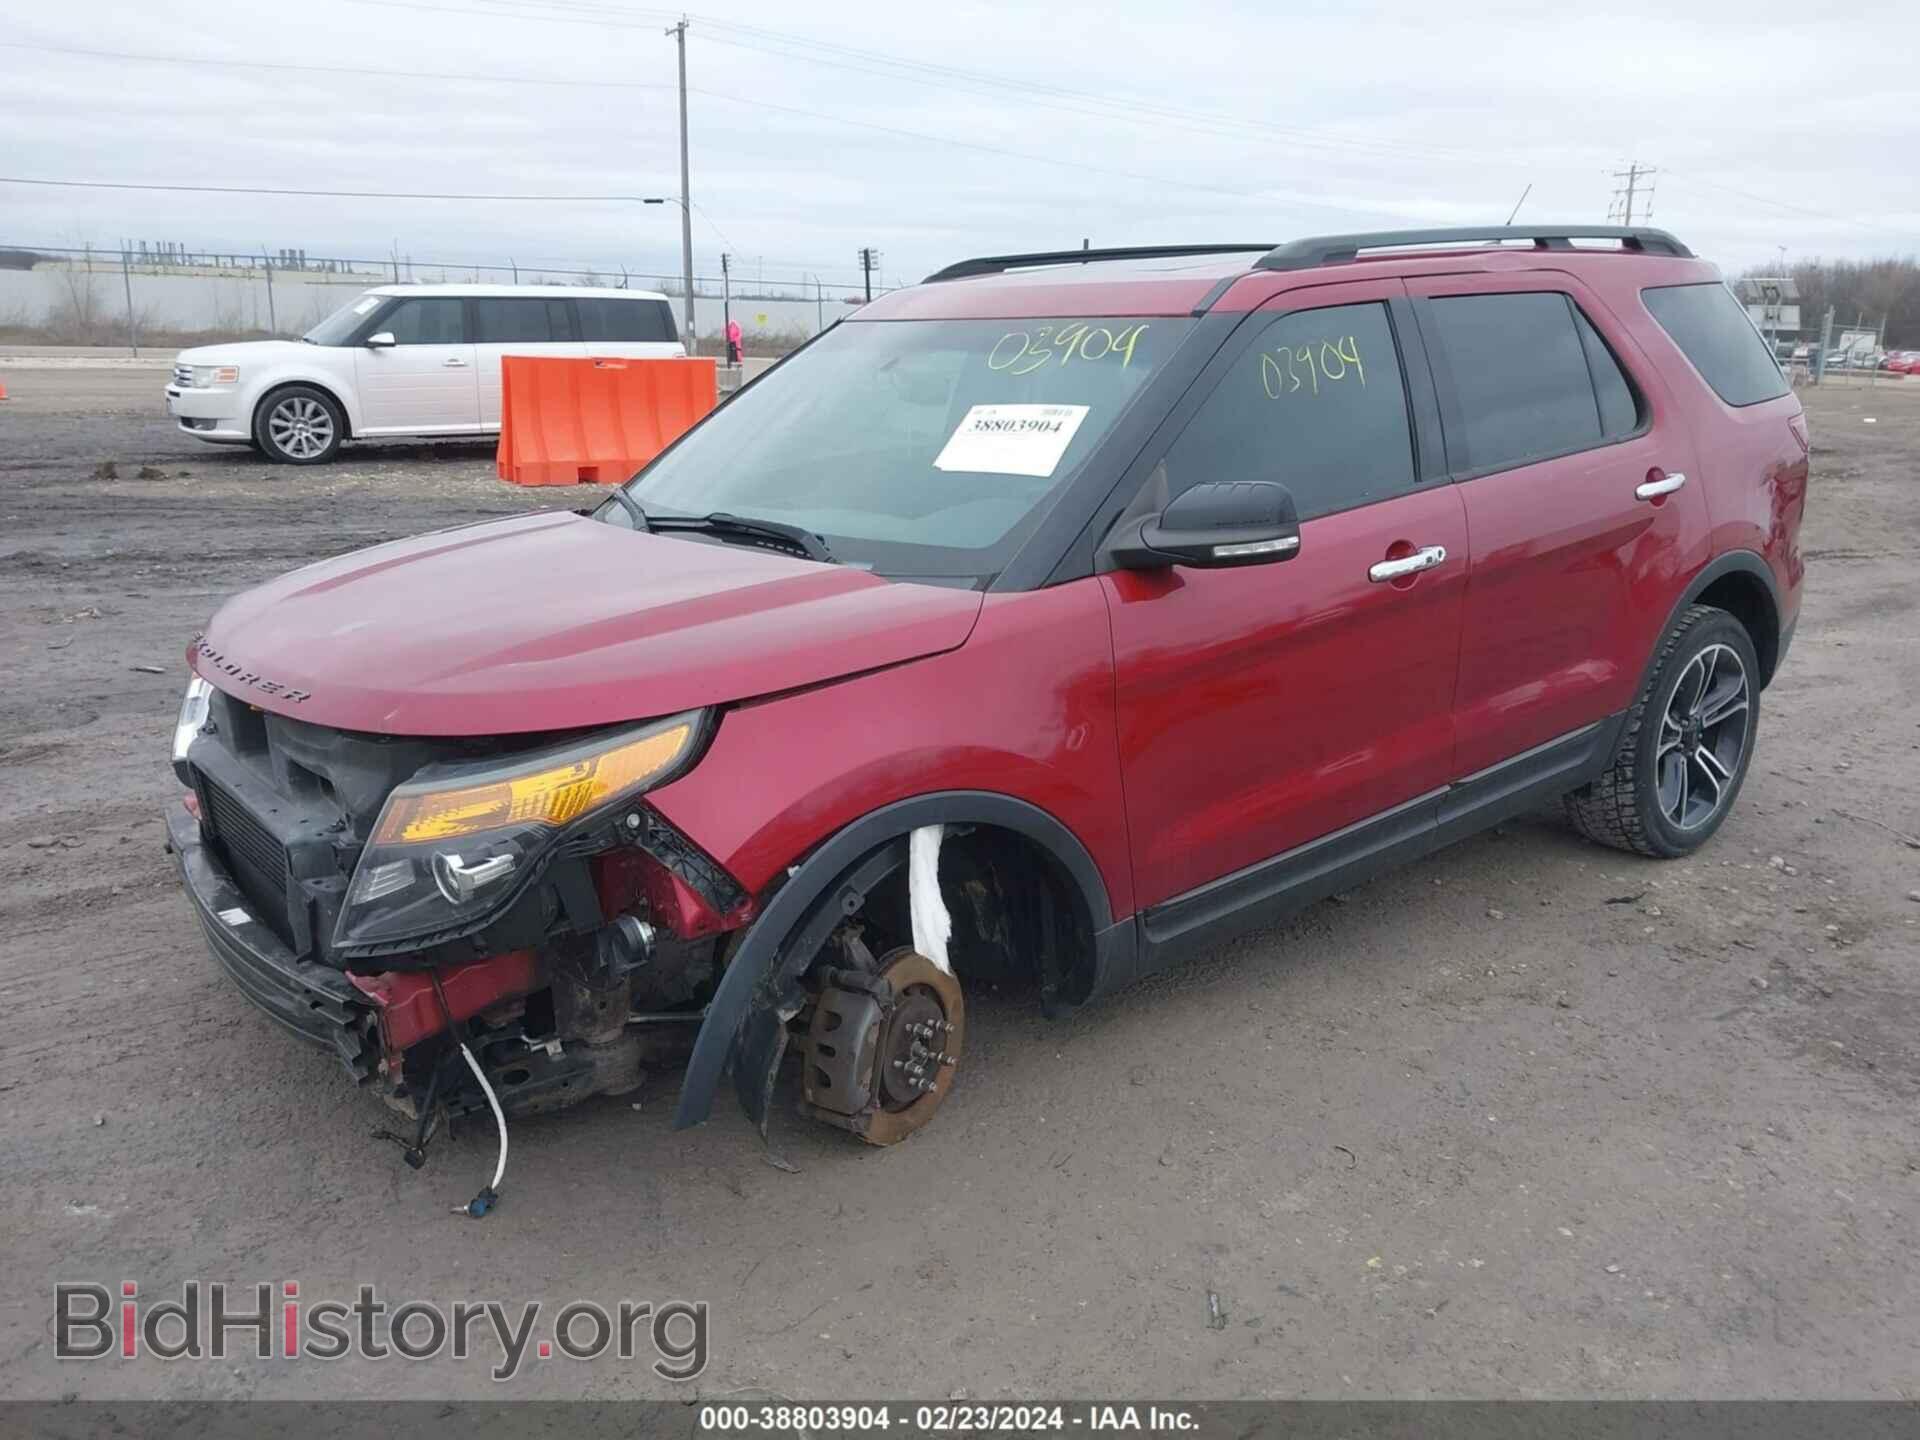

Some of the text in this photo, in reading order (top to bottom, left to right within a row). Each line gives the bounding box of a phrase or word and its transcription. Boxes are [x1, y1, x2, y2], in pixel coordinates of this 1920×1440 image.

[988, 322, 1150, 375] 03904
[1262, 335, 1366, 399] 03904
[968, 419, 1063, 432] 38803904
